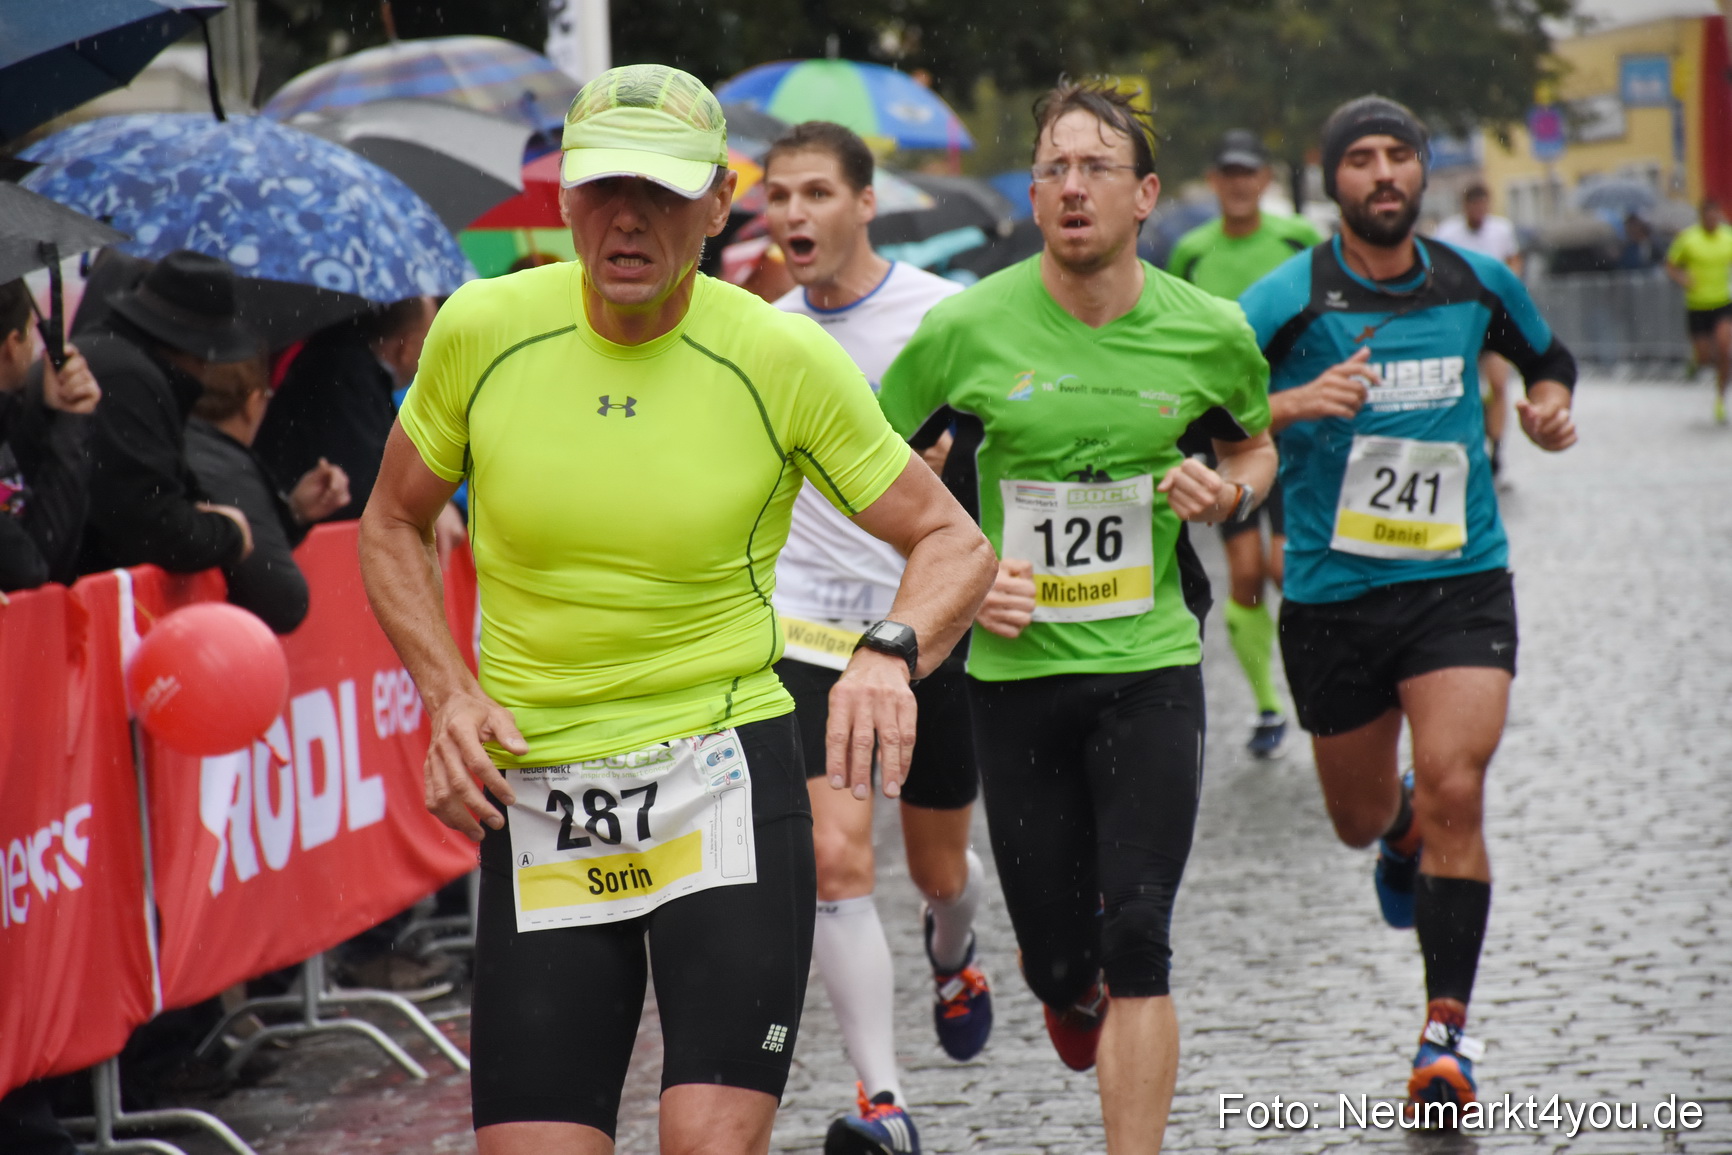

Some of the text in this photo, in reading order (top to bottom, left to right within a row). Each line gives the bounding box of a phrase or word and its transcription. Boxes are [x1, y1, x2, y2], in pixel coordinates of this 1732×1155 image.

[1350, 356, 1464, 388] UBER
[1091, 385, 1137, 397] marathon
[1067, 484, 1141, 505] BOCK
[1369, 466, 1441, 515] 241
[1034, 515, 1123, 568] 126
[1373, 523, 1429, 546] Daniel
[1041, 578, 1118, 602] Michael
[612, 771, 620, 780] by
[622, 769, 643, 779] smart
[545, 781, 658, 851] 287
[521, 854, 530, 865] A
[588, 863, 653, 896] Sorin
[761, 1041, 784, 1053] cep
